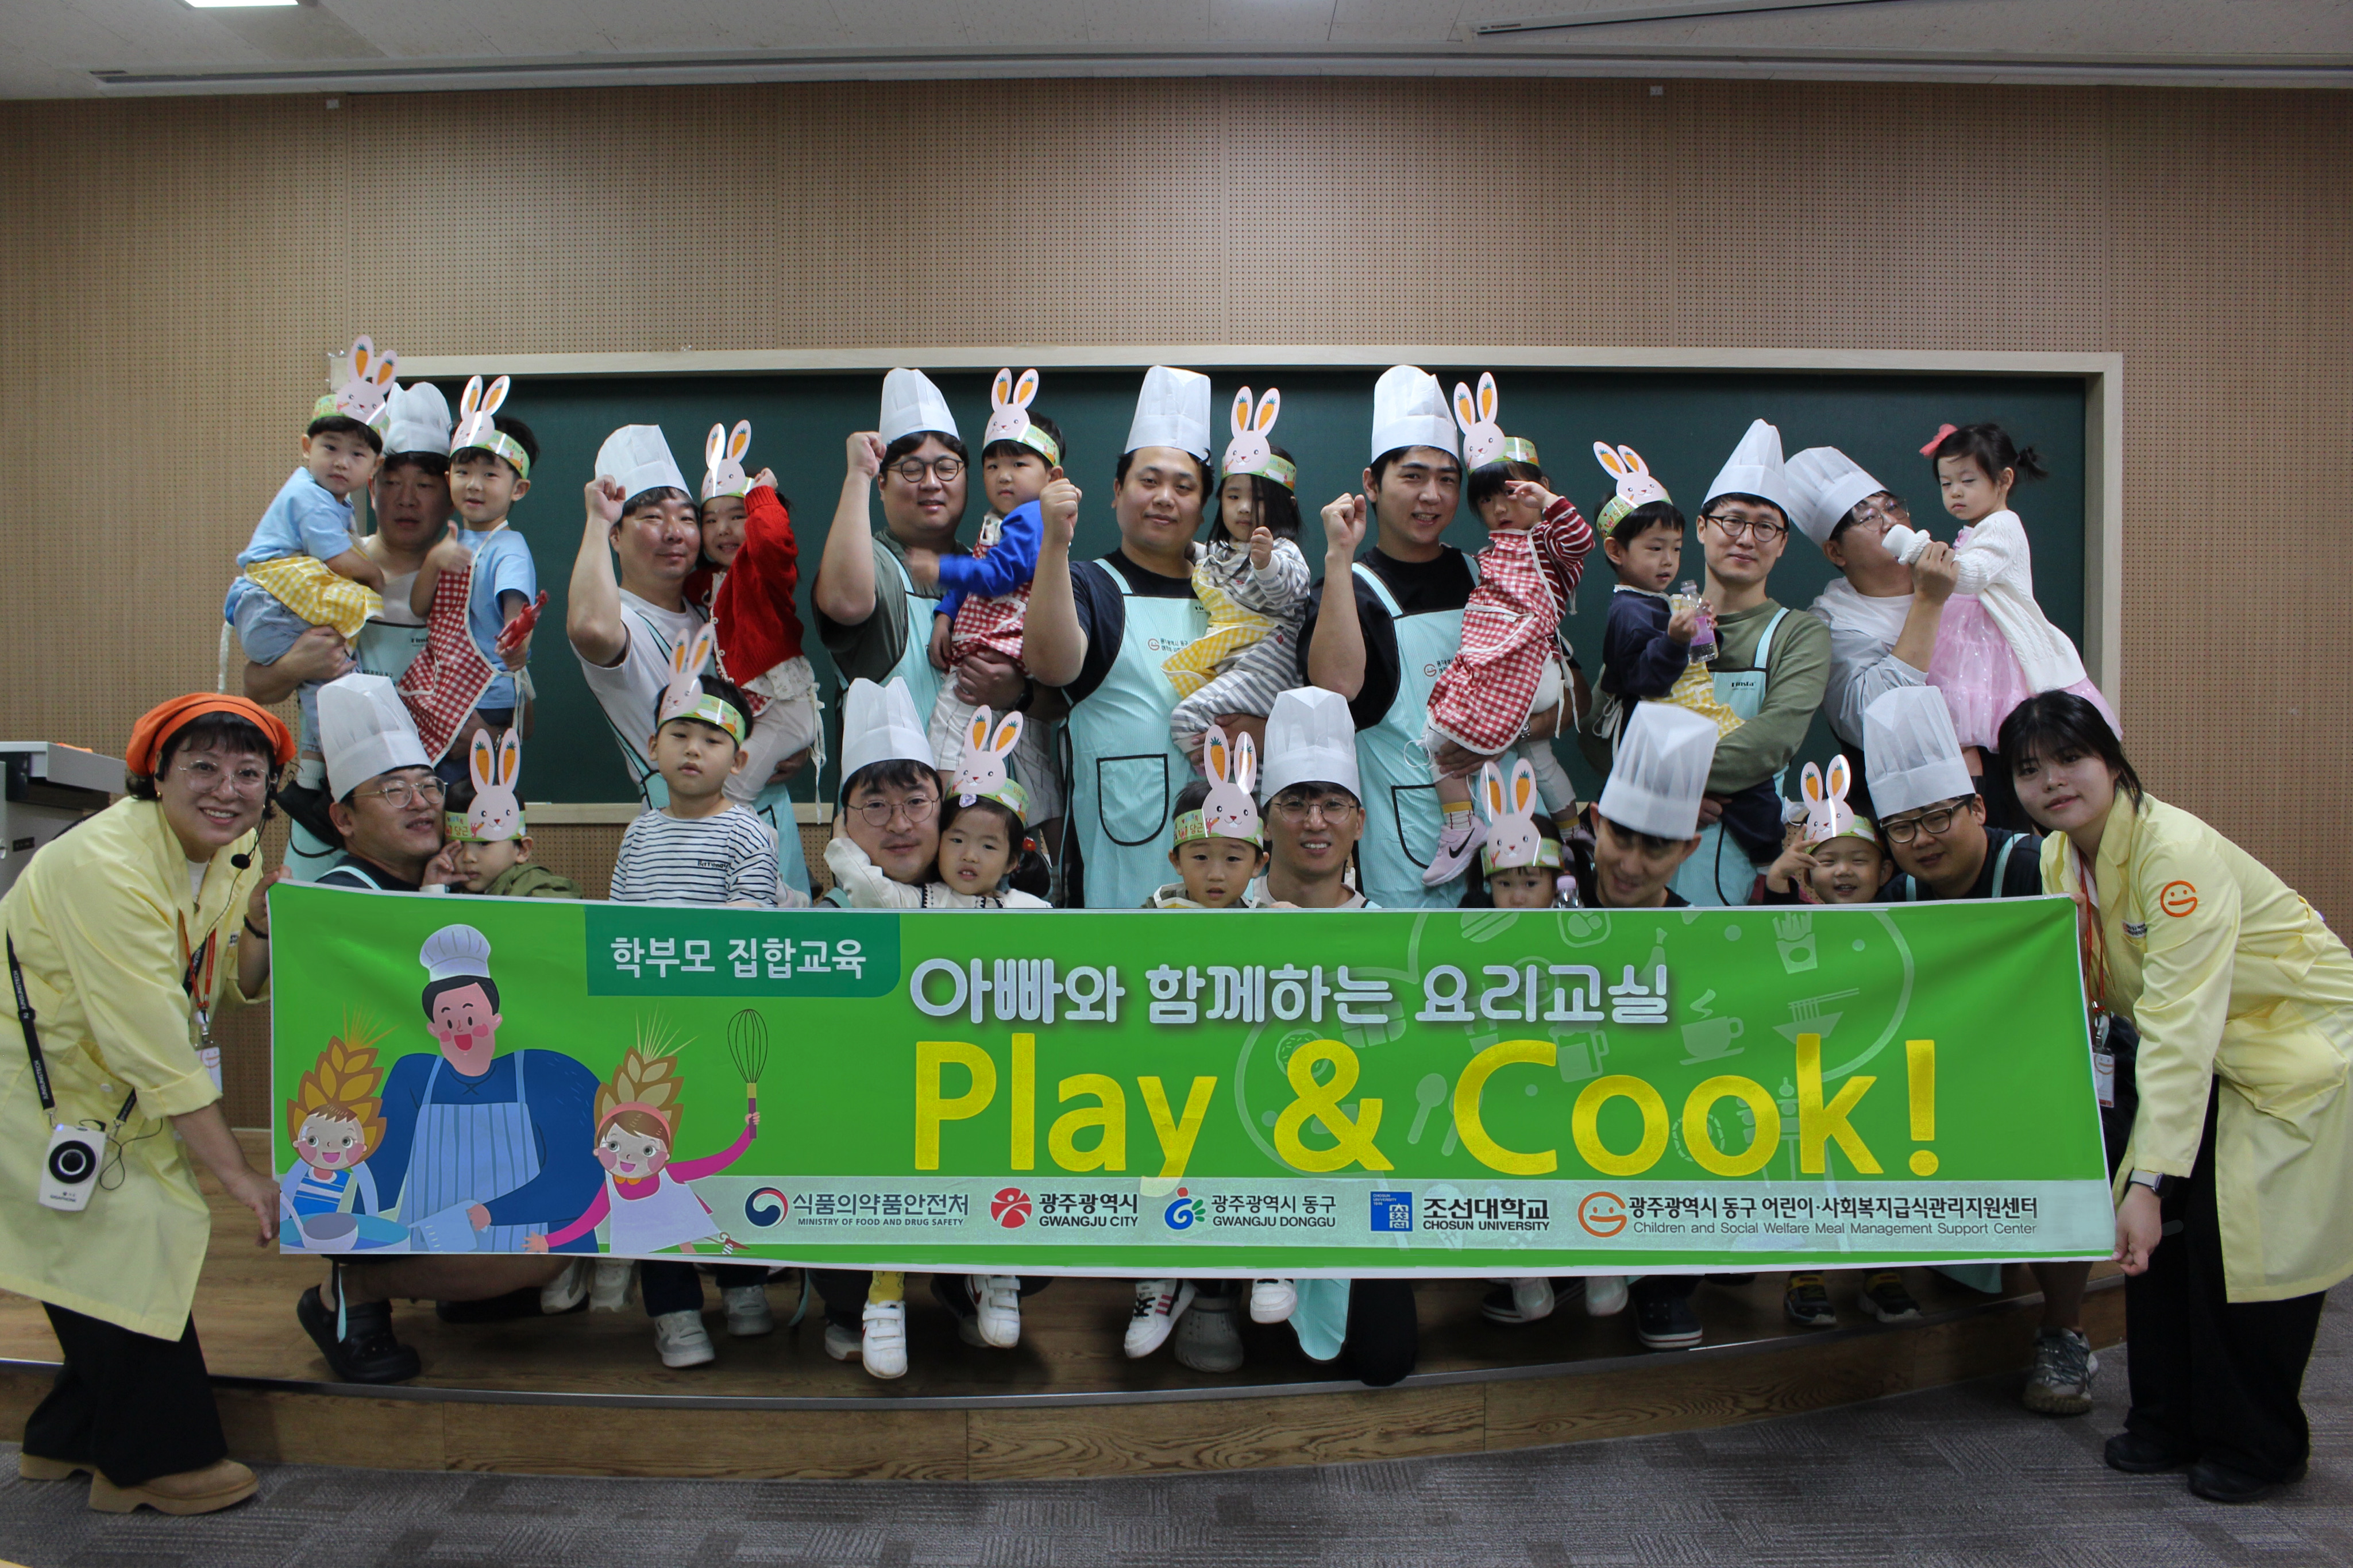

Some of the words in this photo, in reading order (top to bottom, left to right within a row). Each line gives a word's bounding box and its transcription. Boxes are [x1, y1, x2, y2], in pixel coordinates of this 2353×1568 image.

[610, 937, 716, 978] 학부모
[727, 938, 867, 980] 집합교육
[910, 957, 1125, 1024] 아빠와
[1145, 963, 1394, 1024] 함께하는
[1414, 964, 1668, 1024] 요리교실
[915, 1032, 1218, 1198] Play
[1274, 1038, 1395, 1173] &
[1453, 1033, 1939, 1177] Cook!
[793, 1193, 969, 1216] 식품의약품안전처
[1039, 1194, 1138, 1214] 광주광역시
[1211, 1195, 1296, 1214] 광주광역시
[1302, 1195, 1337, 1215] 동구
[1422, 1198, 1549, 1221] 조선대학교
[1629, 1196, 1717, 1219] 광주광역시
[1722, 1198, 1757, 1219] 동구
[1039, 1216, 1107, 1227] GWANGJU
[1109, 1216, 1139, 1227] CITY
[1213, 1216, 1276, 1227] GWANGJU
[1279, 1216, 1336, 1227] DONGGU
[1422, 1221, 1474, 1230] CHOSUN
[1478, 1221, 1550, 1231] UNIVERSITY
[1633, 1221, 1685, 1234] Children
[1691, 1222, 1715, 1234] and
[1721, 1222, 1758, 1234] Social
[1763, 1222, 1810, 1234] Welfare
[1815, 1222, 1845, 1234] Meal
[1850, 1222, 1932, 1236] Management
[1938, 1222, 1988, 1237] Support
[1993, 1222, 2037, 1234] Center
